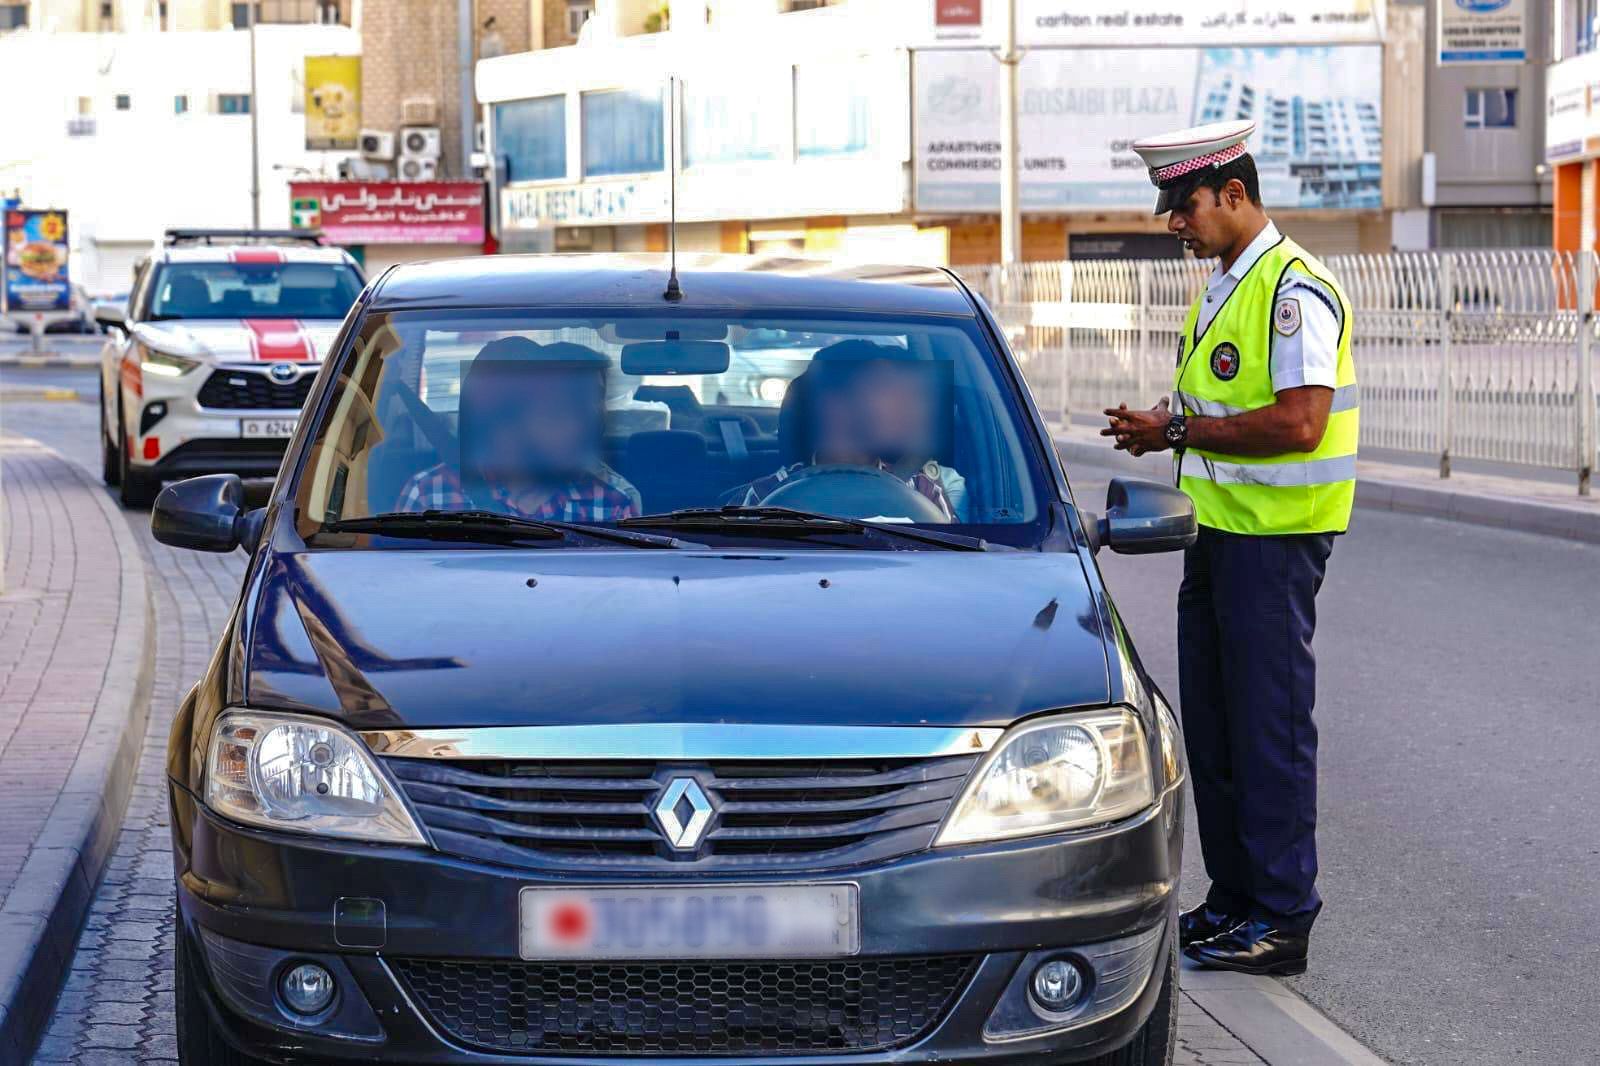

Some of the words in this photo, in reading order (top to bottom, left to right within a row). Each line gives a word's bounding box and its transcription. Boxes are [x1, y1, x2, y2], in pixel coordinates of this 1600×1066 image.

[1035, 11, 1091, 28] carlton
[1096, 10, 1129, 27] real
[1133, 12, 1184, 27] estate
[1020, 87, 1106, 115] GOSAIBI
[1111, 87, 1178, 114] PLAZA
[926, 140, 1004, 155] APARTMEN
[1023, 156, 1067, 172] UNITS
